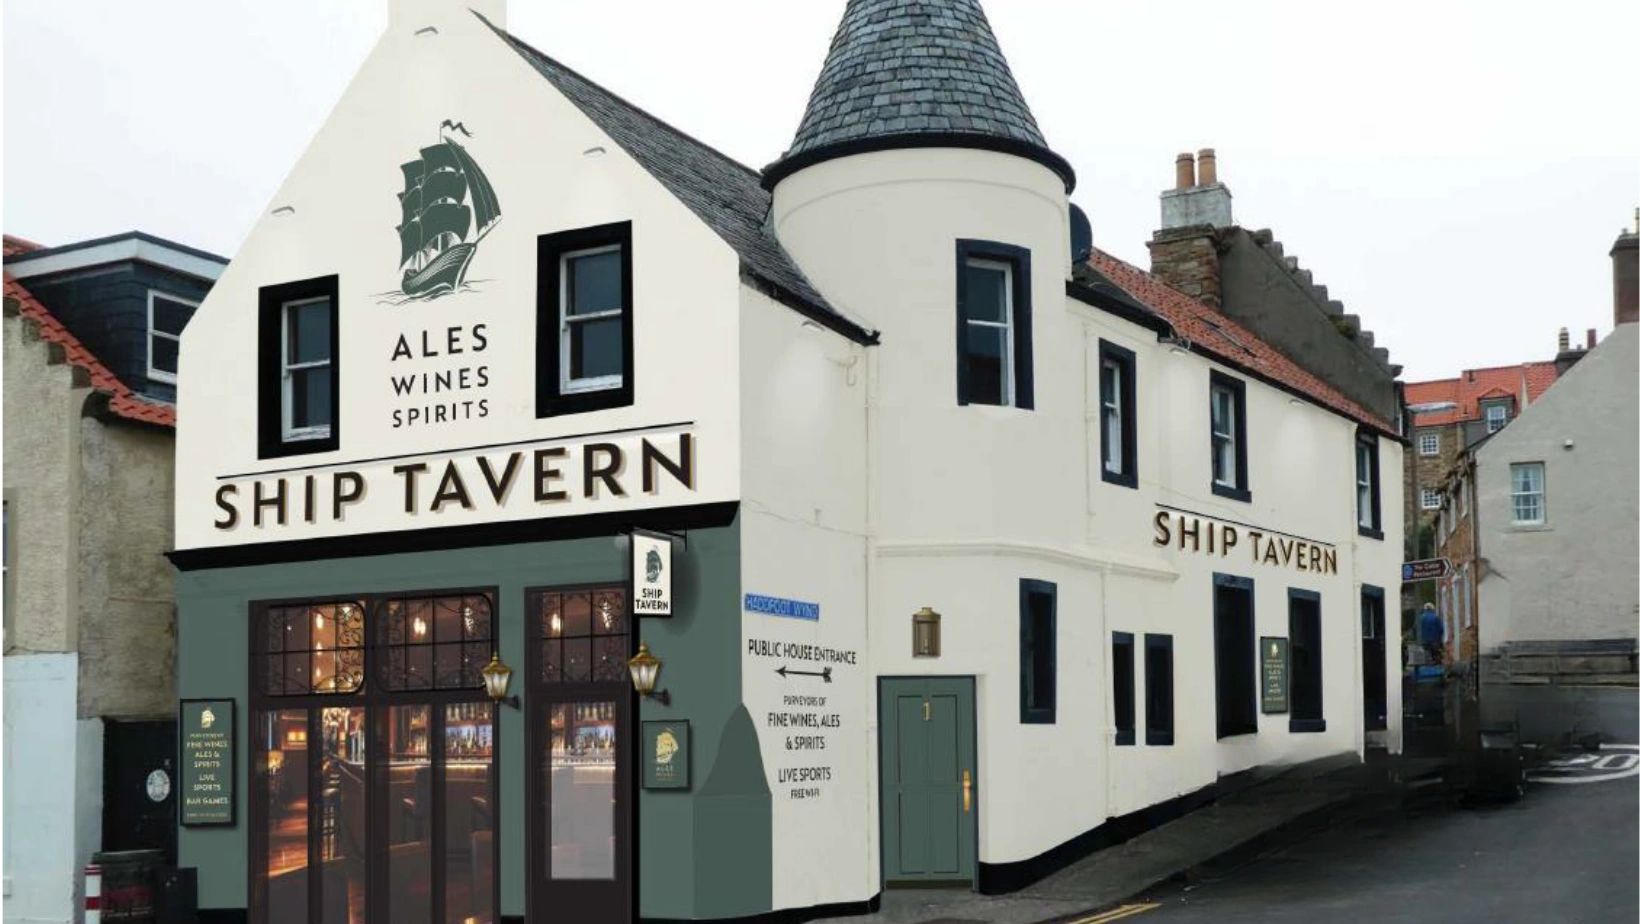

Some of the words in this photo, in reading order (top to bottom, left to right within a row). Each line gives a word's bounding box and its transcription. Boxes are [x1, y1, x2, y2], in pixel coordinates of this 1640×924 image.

[391, 323, 488, 361] ALES
[391, 366, 489, 397] WINES
[392, 399, 489, 428] SPIRITS
[214, 471, 368, 531] SHIP
[393, 432, 697, 515] TAVERN
[1154, 511, 1238, 558] SHIP
[1248, 532, 1338, 575] TAVERN
[642, 588, 663, 599] SHIP
[635, 599, 669, 610] TAVERN
[748, 639, 781, 657] PUBLIC
[783, 643, 813, 660] HOUSE
[814, 647, 857, 665] ENTRANCE
[783, 695, 818, 706] PURVEYORS
[819, 696, 827, 706] OF
[923, 702, 929, 721] 1
[768, 713, 788, 727] FINE
[789, 713, 820, 728] WINES,
[821, 714, 841, 727] ALES
[785, 736, 792, 750] &
[795, 736, 826, 750] SPIRITS
[779, 767, 798, 782] LIVE
[799, 767, 831, 782] SPORTS
[203, 797, 229, 805] GAMES
[791, 788, 804, 799] FREE
